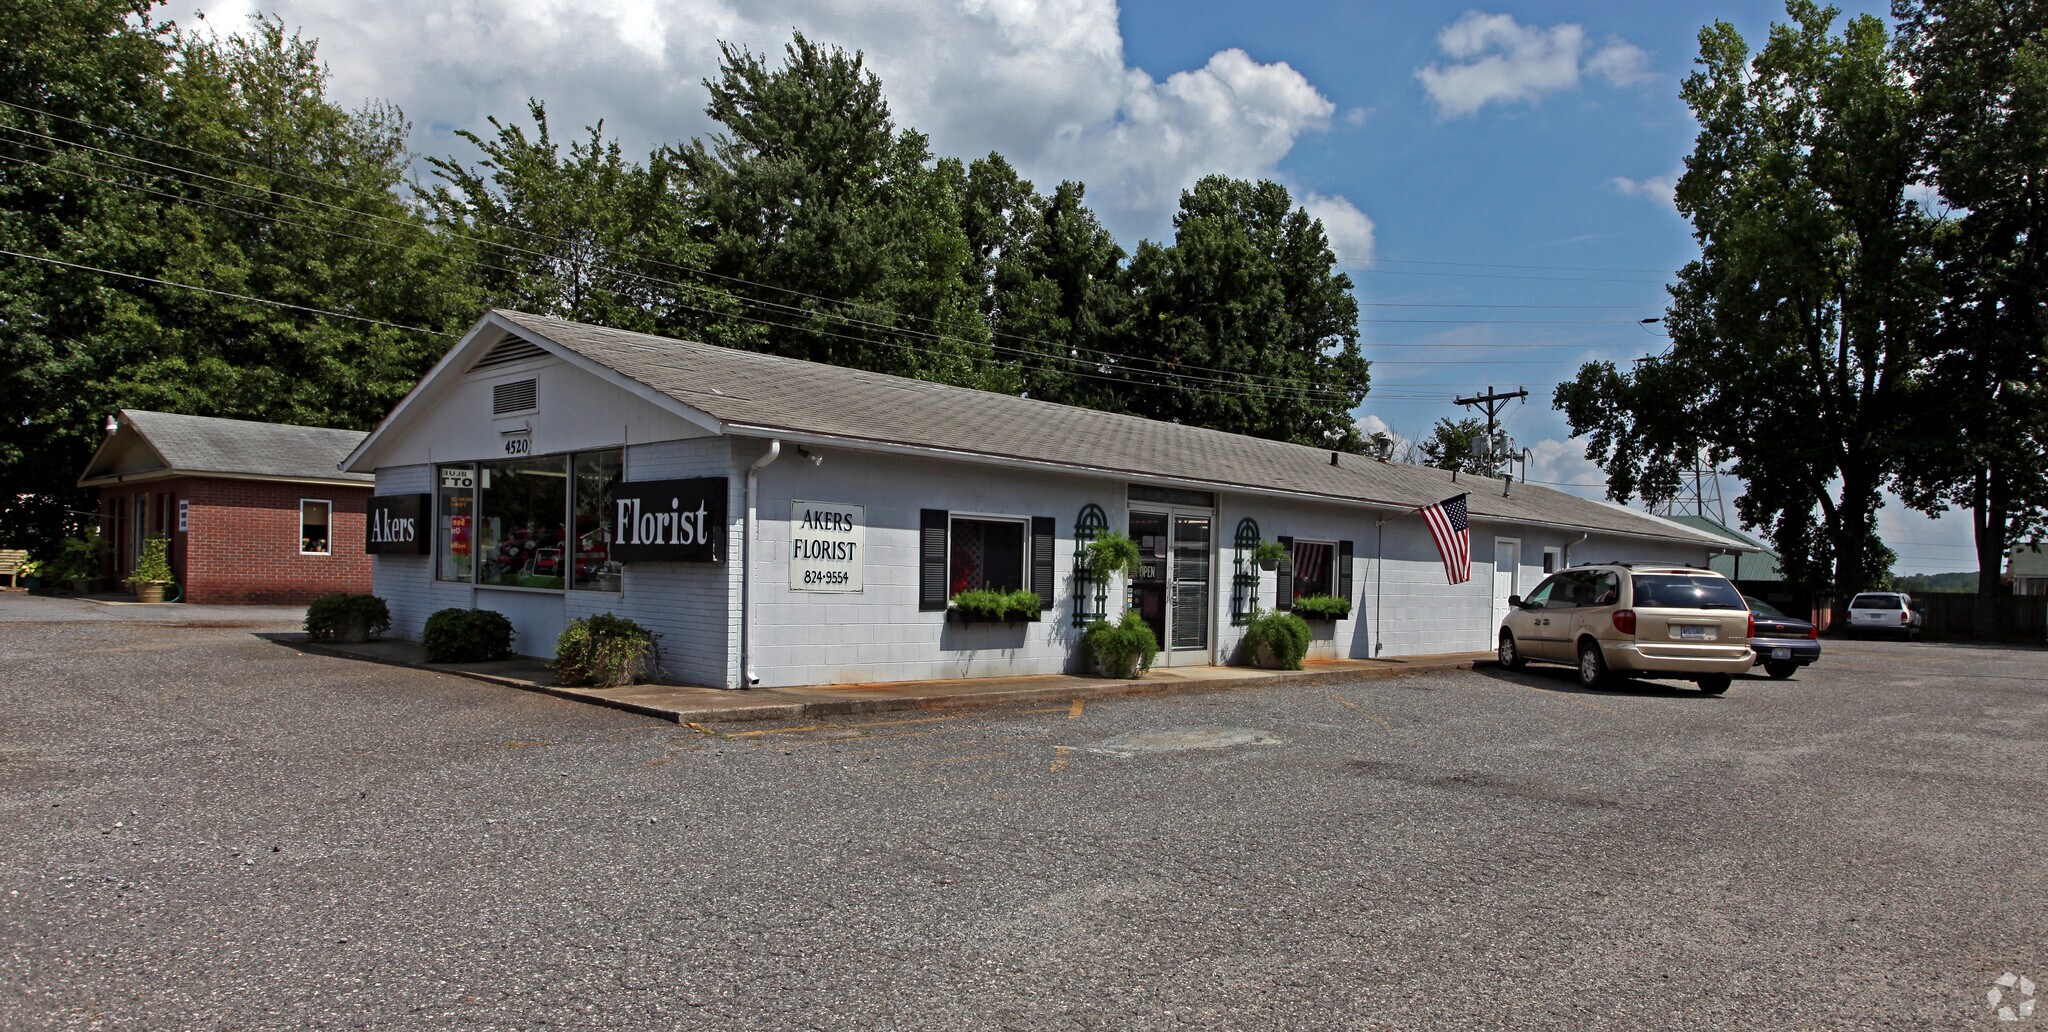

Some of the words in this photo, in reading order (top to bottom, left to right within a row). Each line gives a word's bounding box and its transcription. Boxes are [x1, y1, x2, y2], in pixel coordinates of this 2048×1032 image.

[505, 439, 528, 455] 4520
[371, 508, 415, 542] Akers
[615, 497, 708, 545] Florist
[801, 509, 853, 532] AKERS
[794, 538, 857, 561] FLORIST
